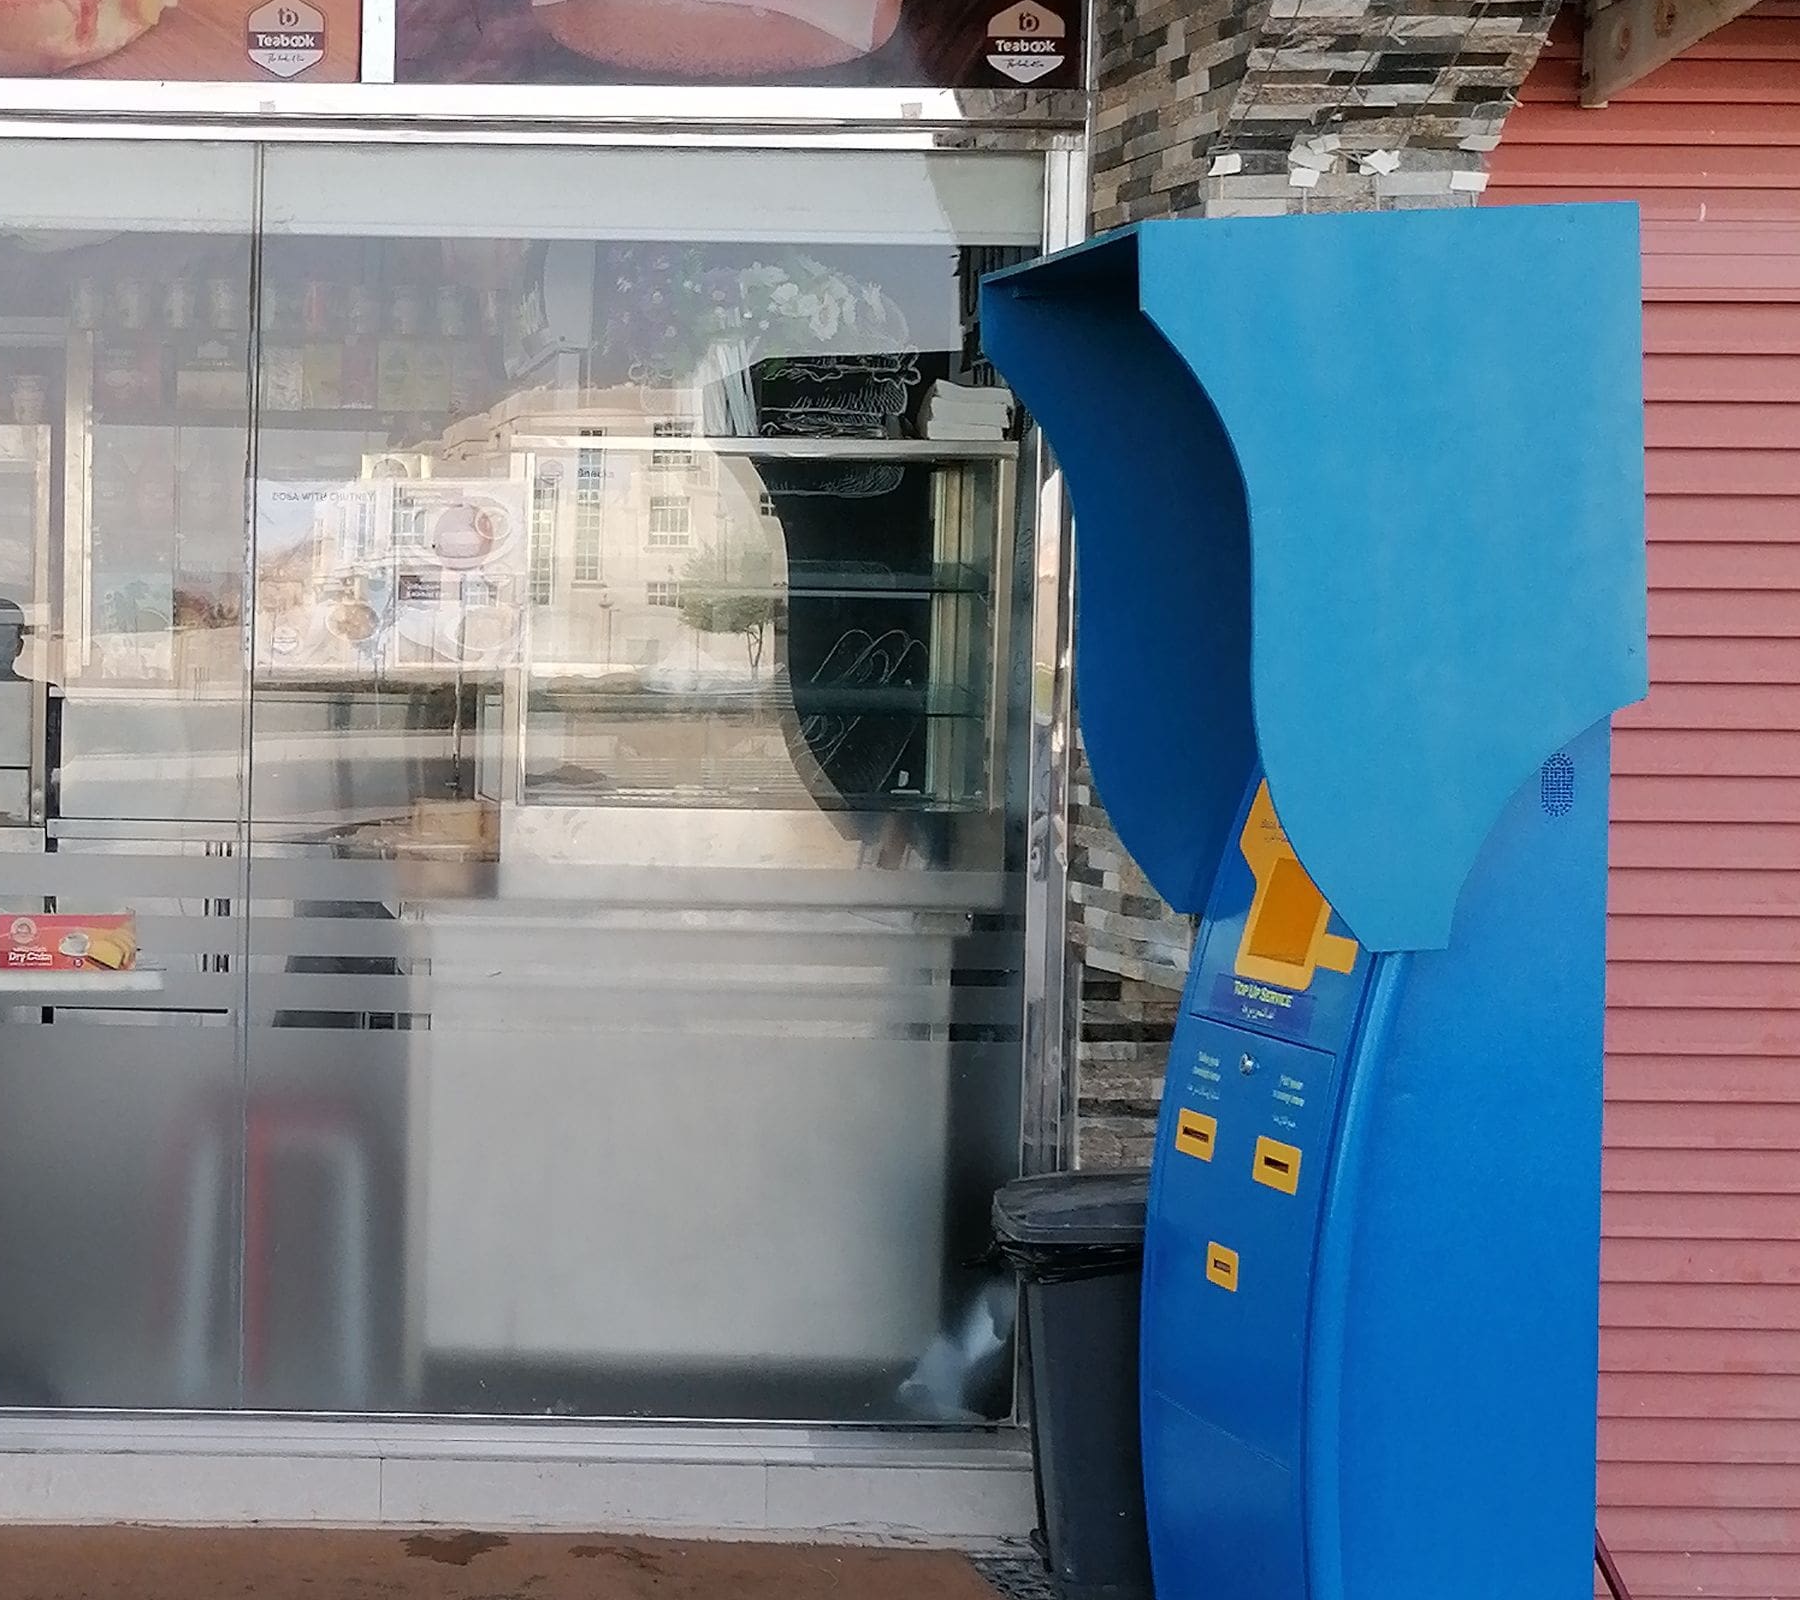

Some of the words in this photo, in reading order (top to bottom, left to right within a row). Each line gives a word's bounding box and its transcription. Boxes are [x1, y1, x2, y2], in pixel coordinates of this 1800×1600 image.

[256, 34, 315, 48] Teabook
[995, 39, 1056, 53] Teabook
[301, 492, 327, 502] WITH
